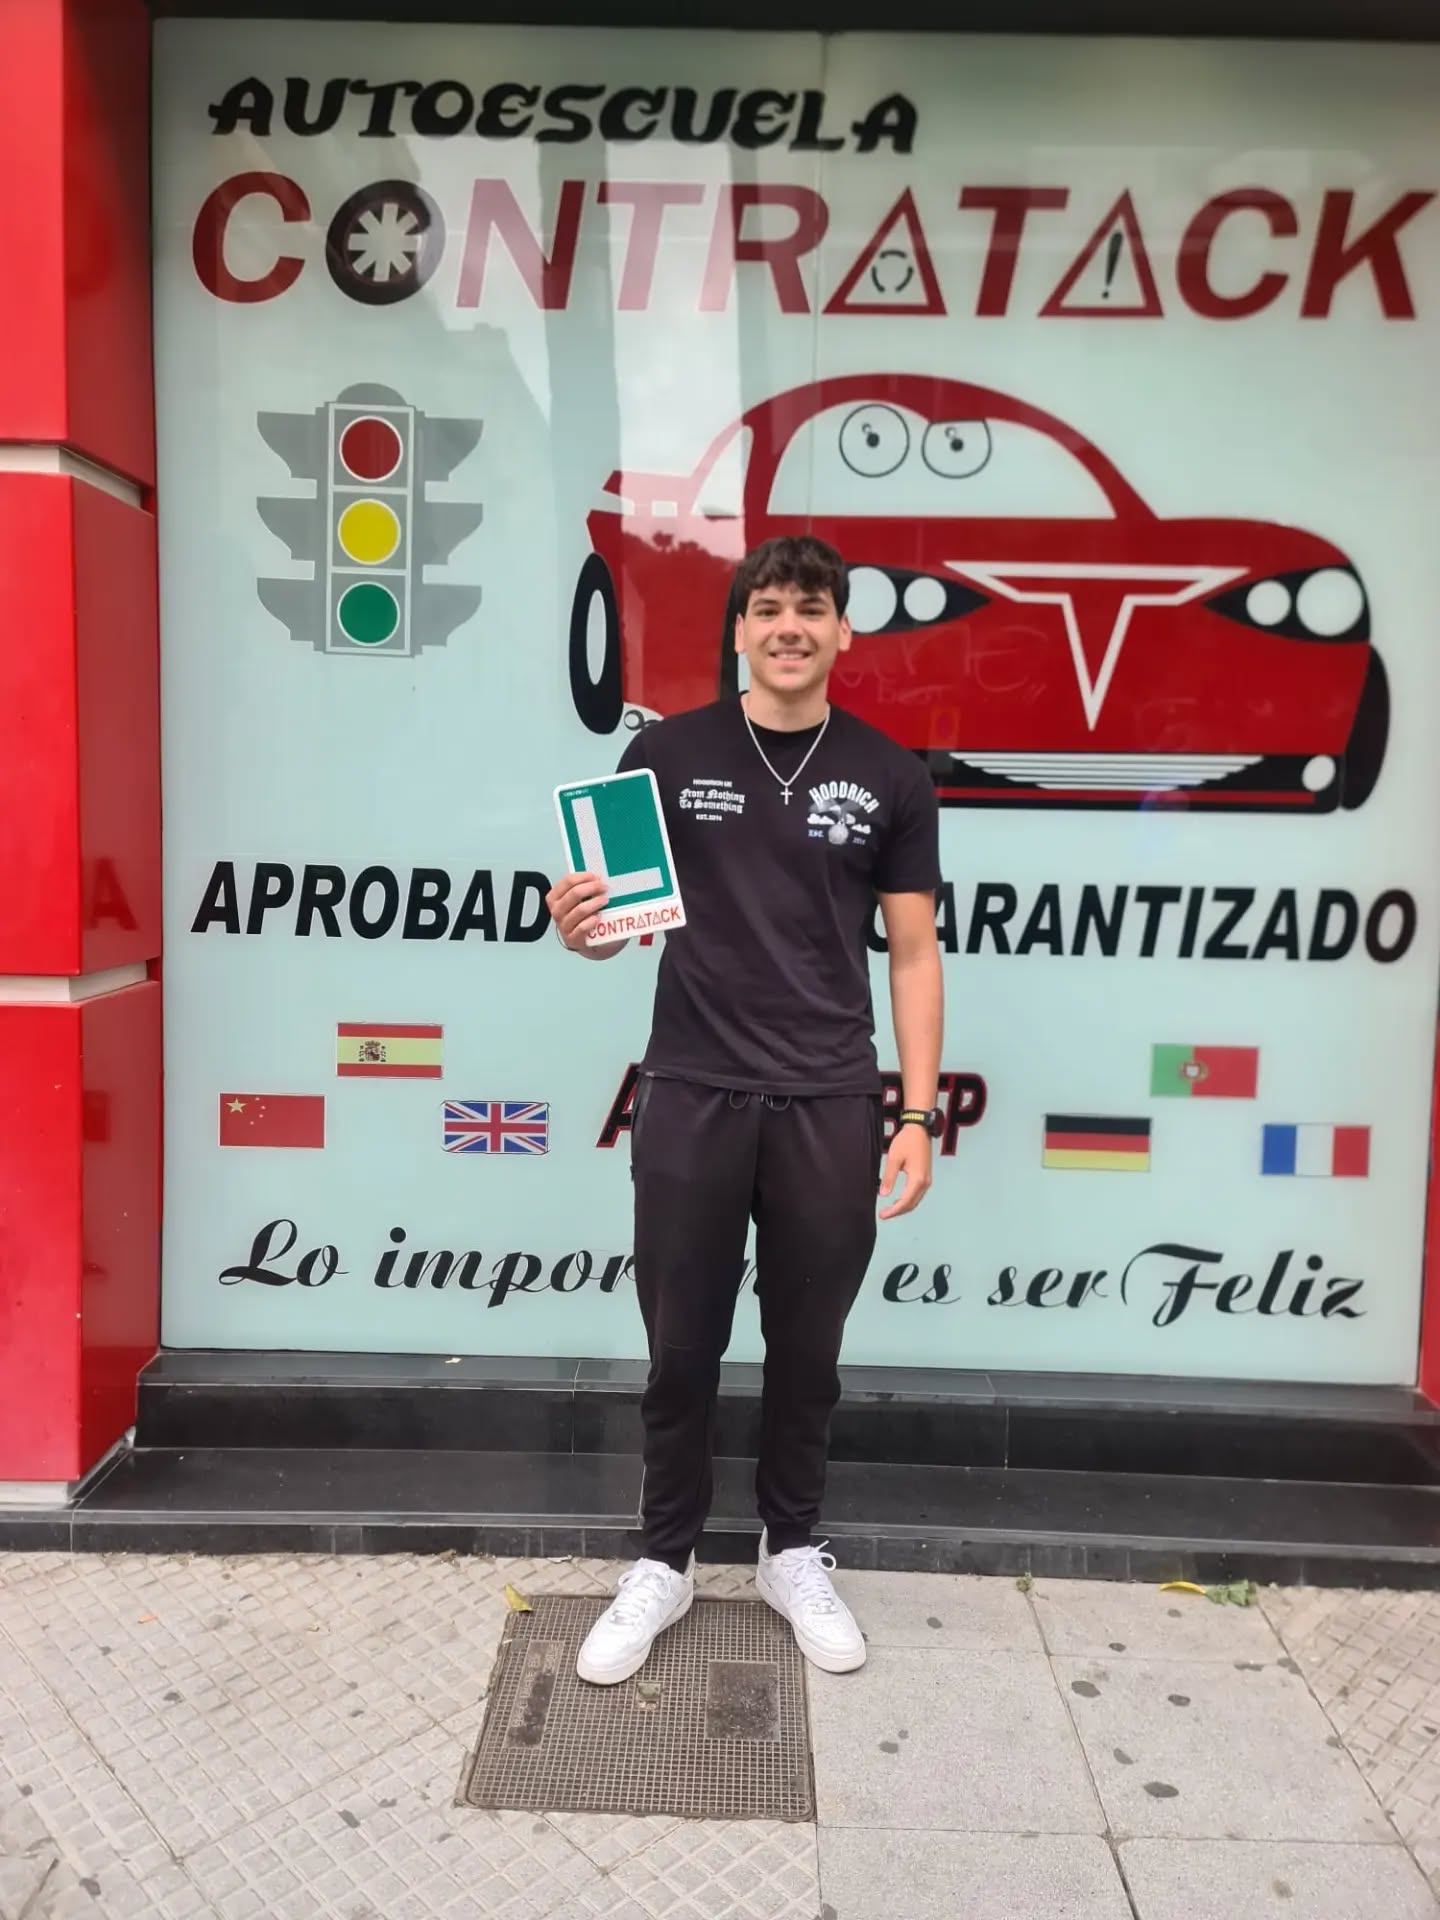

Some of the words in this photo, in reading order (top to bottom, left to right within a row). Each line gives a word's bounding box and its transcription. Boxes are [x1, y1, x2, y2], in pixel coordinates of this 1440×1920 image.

[208, 77, 918, 153] AUTOESCUELA
[192, 171, 1440, 322] CONTRATACK
[679, 788, 705, 800] From
[706, 789, 746, 804] Nothing
[693, 799, 744, 815] Something
[808, 780, 879, 814] HOODRICH
[570, 796, 664, 899] L
[190, 860, 553, 943] APROBAD
[881, 1070, 988, 1156] BP
[218, 1219, 349, 1288] Lo
[374, 1226, 758, 1310] impor
[882, 1262, 961, 1304] es
[986, 1264, 1108, 1309] ser
[1120, 1243, 1366, 1328] Feliz
